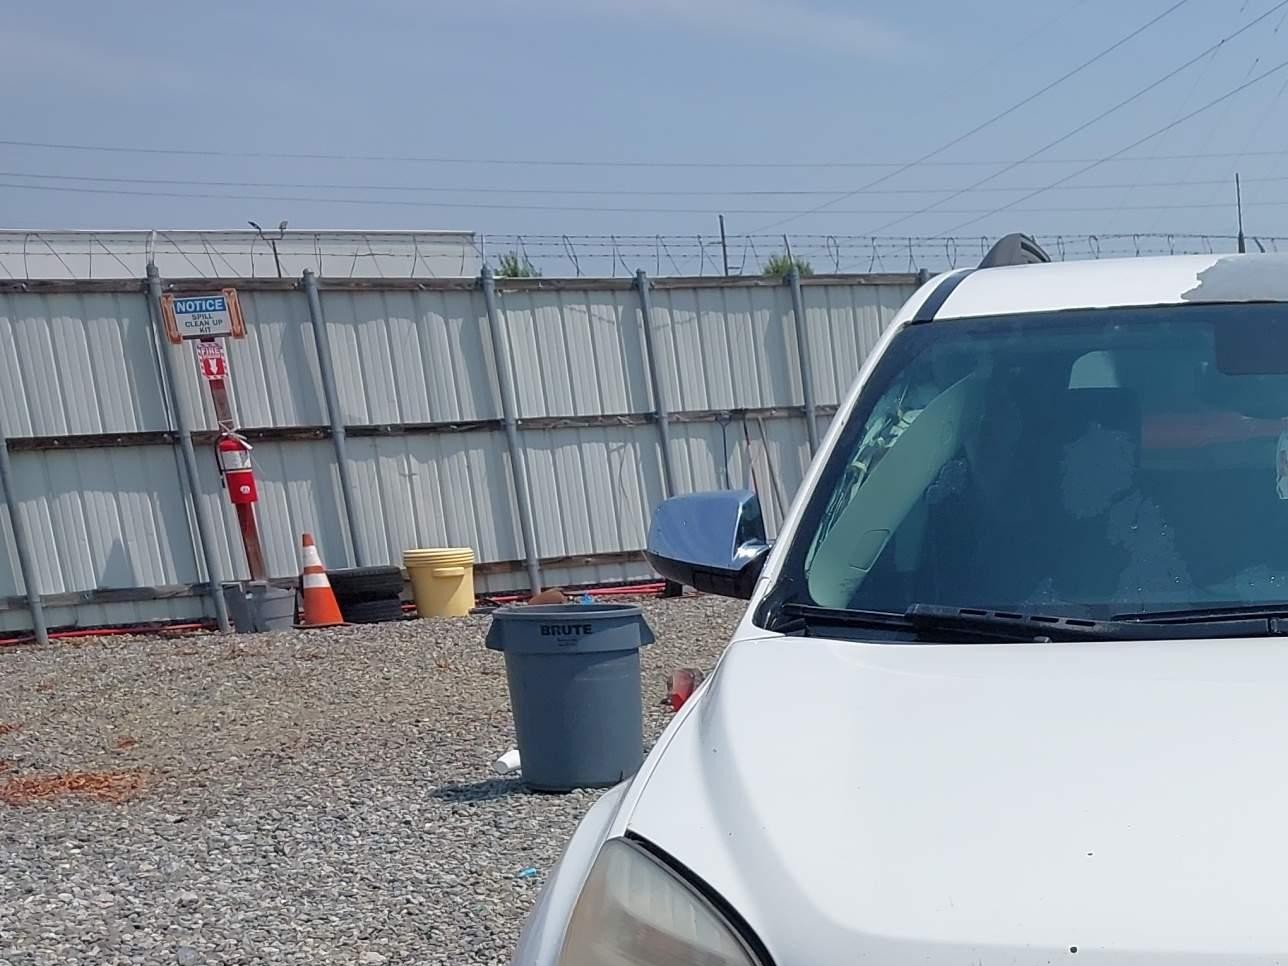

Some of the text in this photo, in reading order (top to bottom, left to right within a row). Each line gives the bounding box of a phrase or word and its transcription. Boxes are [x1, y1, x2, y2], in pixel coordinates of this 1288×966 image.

[176, 299, 224, 312] NOTICE
[184, 320, 210, 328] CLEAN
[540, 624, 593, 636] BRUTE
